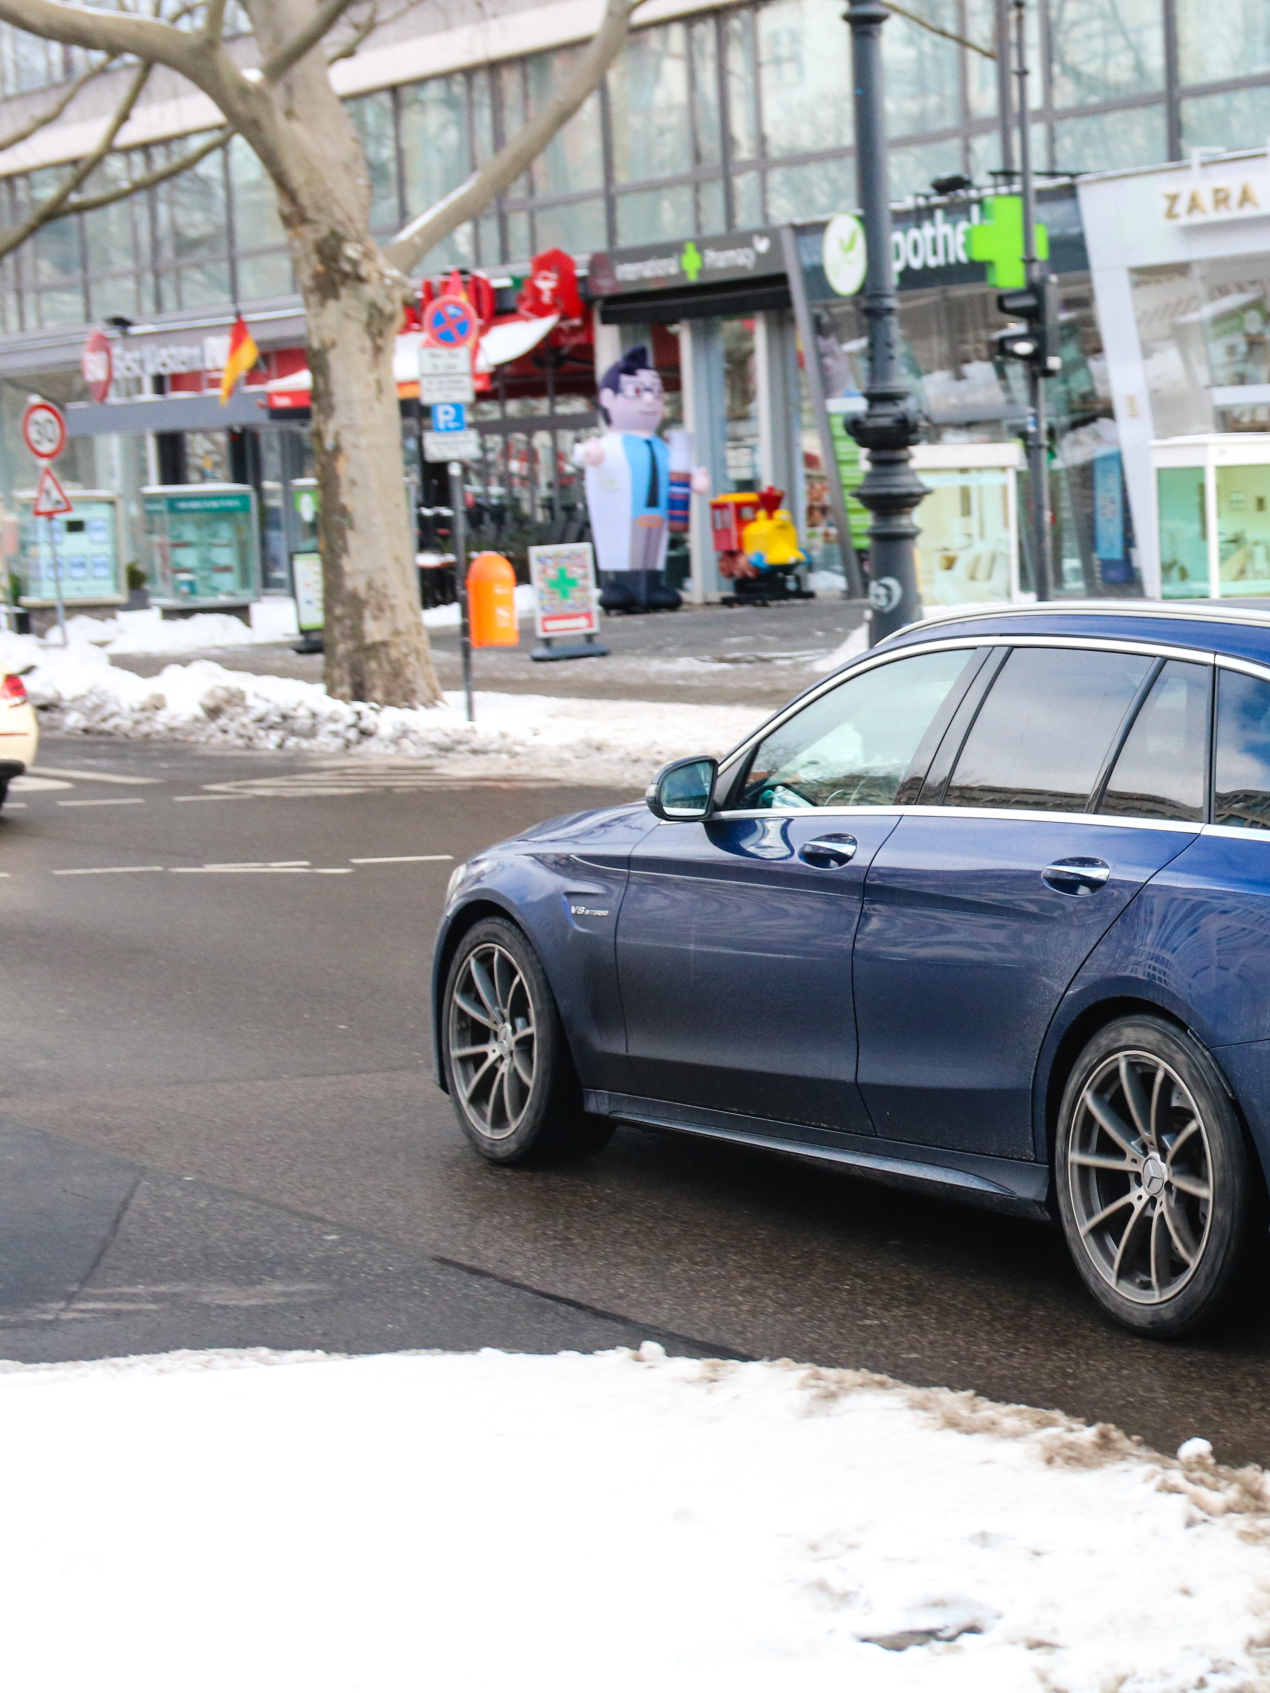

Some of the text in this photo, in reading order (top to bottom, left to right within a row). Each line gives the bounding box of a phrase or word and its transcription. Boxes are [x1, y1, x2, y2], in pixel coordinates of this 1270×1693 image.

[1163, 184, 1259, 219] ZARA
[32, 418, 55, 445] 30
[571, 905, 586, 915] V8
